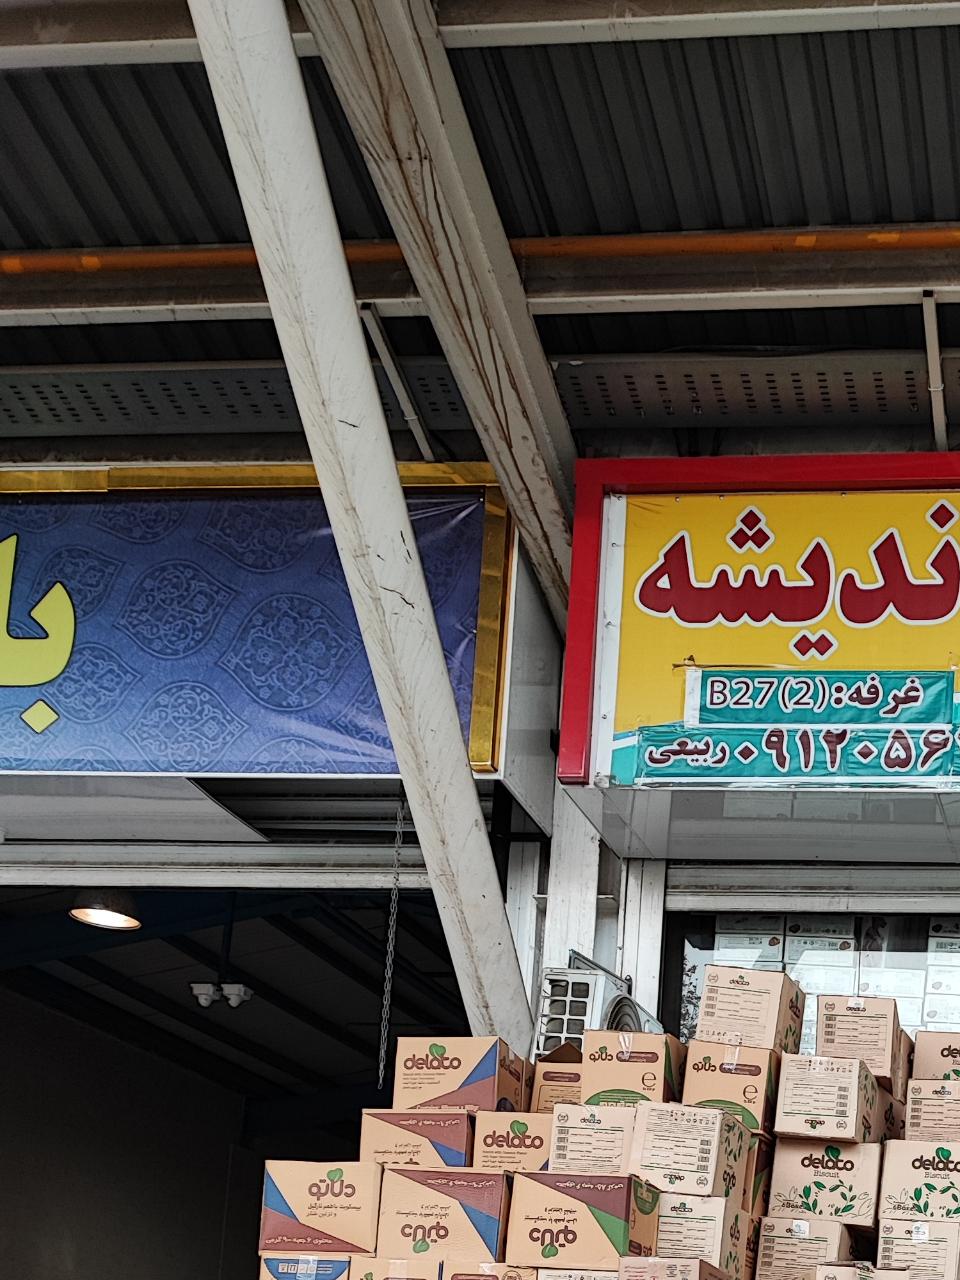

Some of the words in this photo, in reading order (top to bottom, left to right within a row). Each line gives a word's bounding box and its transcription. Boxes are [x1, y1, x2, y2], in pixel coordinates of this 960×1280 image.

[644, 735, 730, 769] ربیعی
[403, 1053, 462, 1070] delato
[483, 1130, 544, 1149] delato
[800, 1153, 855, 1172] delato
[308, 1178, 356, 1200] دلاتو
[400, 1220, 449, 1243] دلاتو
[528, 1225, 578, 1248] دلاتو
